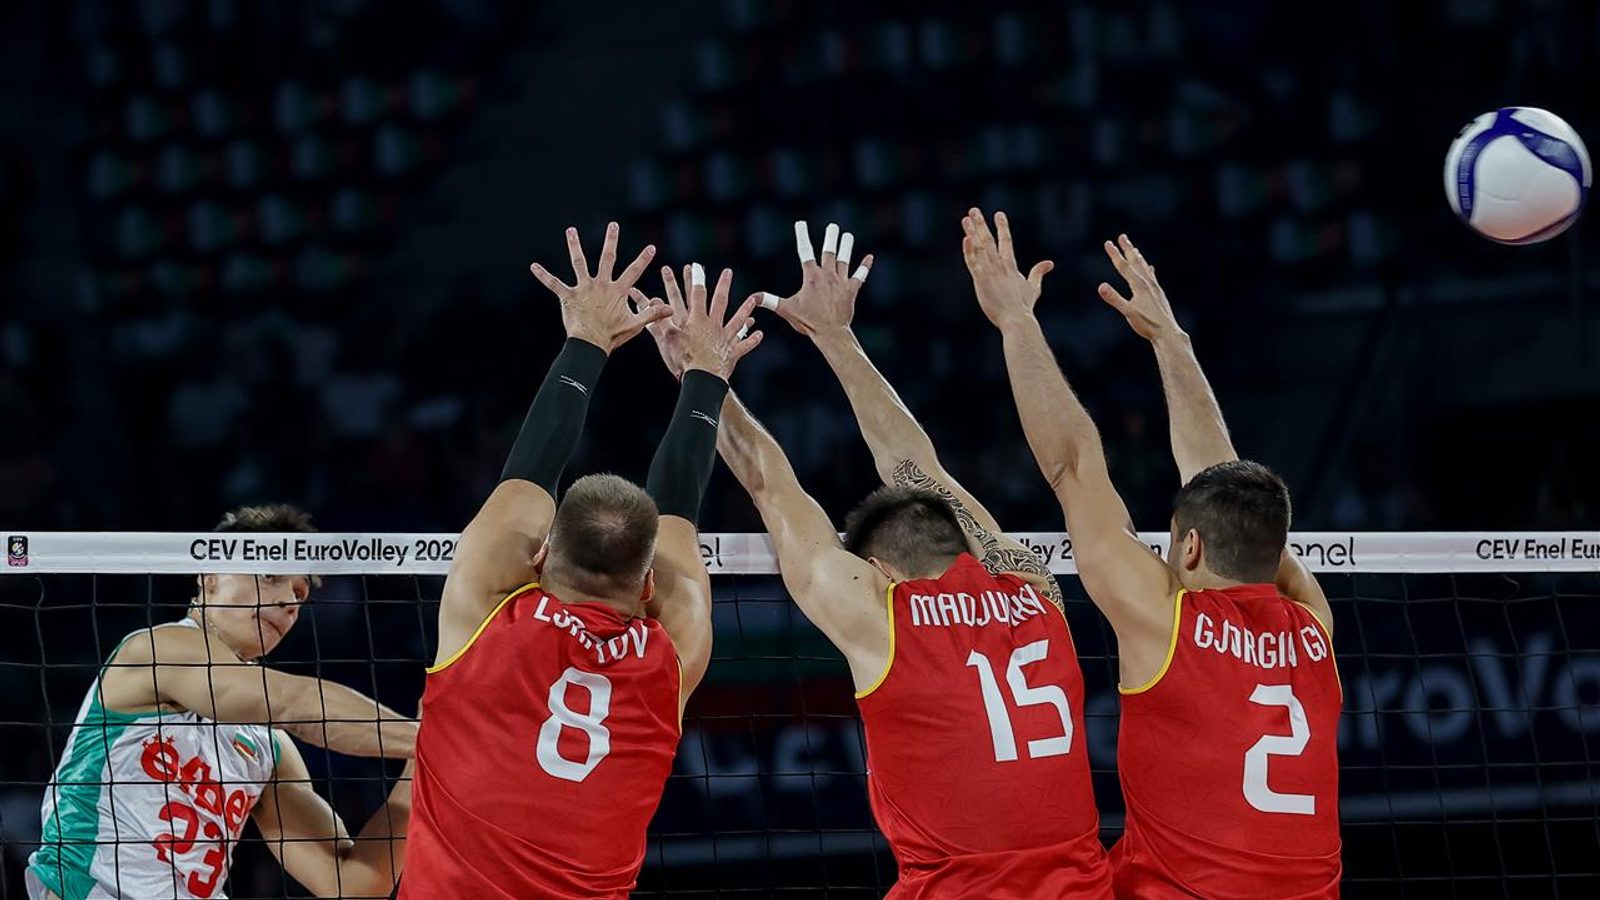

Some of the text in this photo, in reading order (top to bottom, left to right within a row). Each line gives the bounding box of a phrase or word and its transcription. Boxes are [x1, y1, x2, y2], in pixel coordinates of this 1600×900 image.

[190, 538, 458, 566] CEV Enel EuroVolley 202
[1476, 538, 1520, 560] CEV
[1524, 537, 1566, 559] Enel
[536, 666, 612, 783] 8
[965, 639, 1074, 762] 15
[1242, 683, 1316, 815] 2
